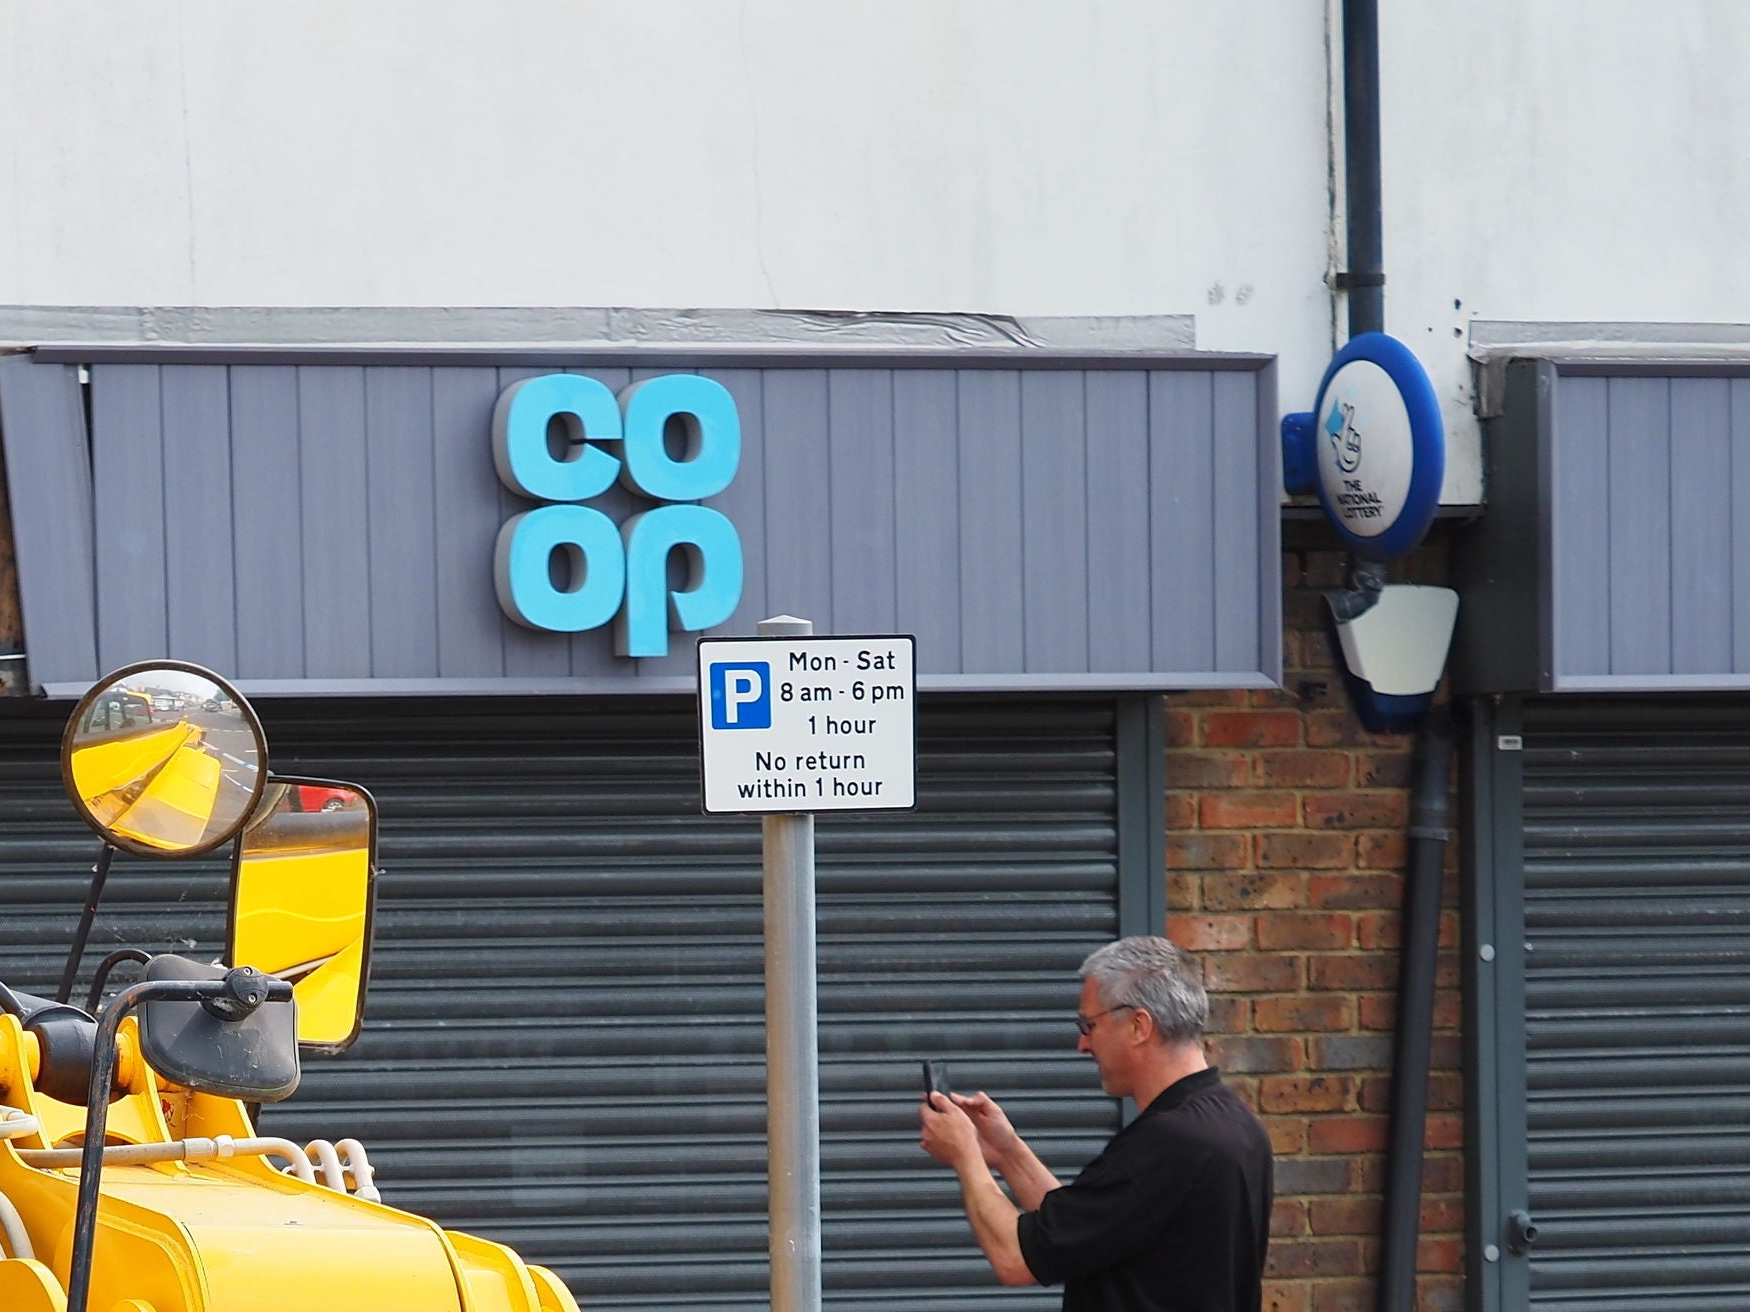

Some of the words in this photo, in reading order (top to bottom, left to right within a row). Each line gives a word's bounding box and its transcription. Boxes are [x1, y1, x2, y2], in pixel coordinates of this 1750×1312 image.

[1344, 480, 1362, 491] THE
[788, 651, 837, 672] Mon
[856, 650, 896, 671] Sat
[724, 669, 763, 724] P
[780, 682, 794, 702] 8
[800, 686, 833, 702] am
[852, 681, 866, 701] 6
[872, 684, 905, 704] pm
[808, 715, 817, 735] 1
[826, 715, 877, 735] hour
[756, 751, 787, 771] No
[796, 751, 866, 771] return
[737, 779, 807, 799] within
[815, 777, 824, 797] 1
[833, 777, 883, 796] hour
